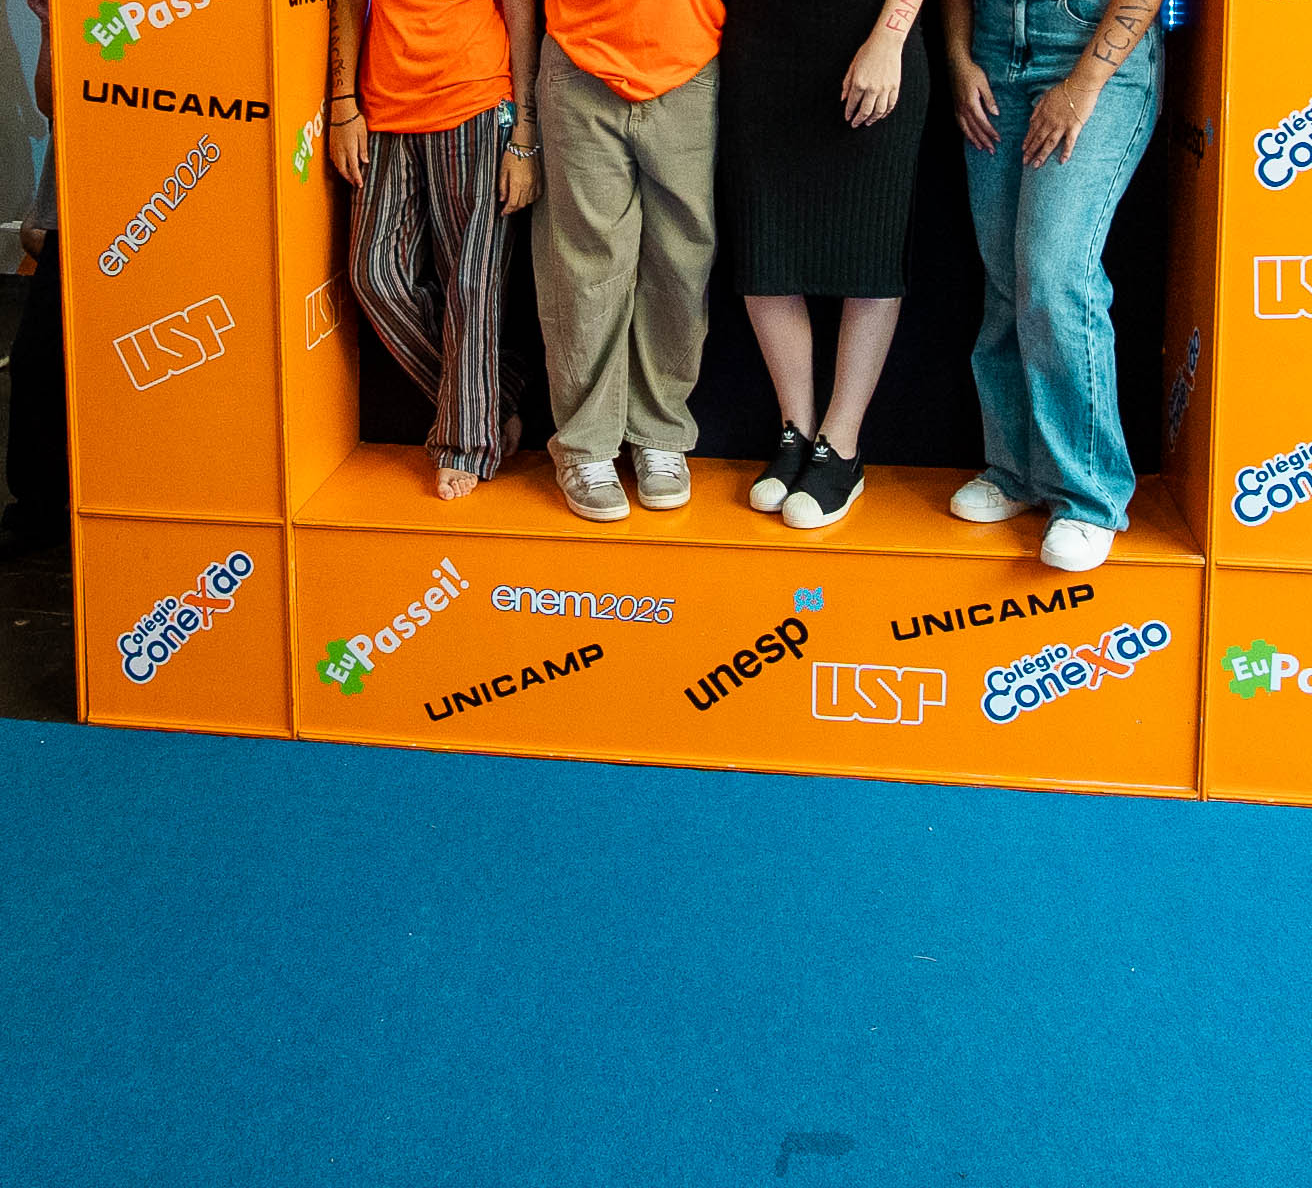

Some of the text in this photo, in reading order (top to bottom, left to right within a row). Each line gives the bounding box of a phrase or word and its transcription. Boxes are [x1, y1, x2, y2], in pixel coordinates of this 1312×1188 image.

[90, 14, 126, 48] Eu
[82, 80, 270, 123] UNICAMP
[98, 133, 222, 278] enem2025
[113, 295, 235, 392] USP
[119, 595, 177, 657] Colégio
[325, 557, 471, 685] Eu Passei!
[490, 583, 676, 625] enem2025
[890, 583, 1095, 641] UNICAMP
[423, 643, 605, 723] UNICAMP
[684, 616, 809, 712] unesp
[811, 660, 947, 725] USP
[986, 645, 1068, 696] Colégio
[1231, 655, 1270, 682] Eu
